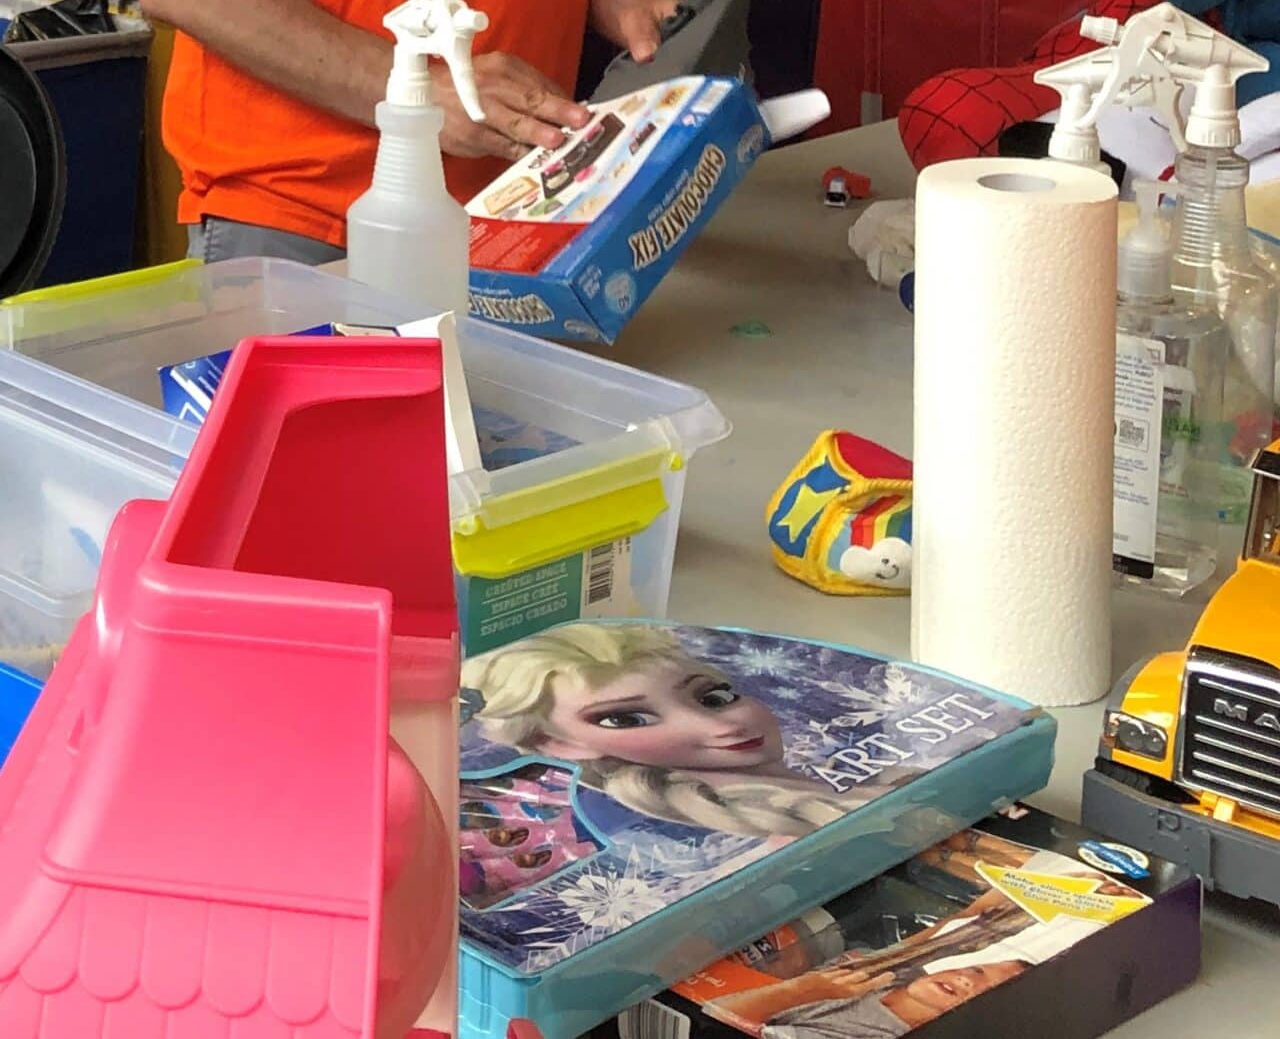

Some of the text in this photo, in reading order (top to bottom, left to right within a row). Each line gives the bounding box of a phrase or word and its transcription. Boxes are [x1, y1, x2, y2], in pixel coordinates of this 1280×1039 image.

[657, 145, 726, 249] CHOCOLATE
[630, 228, 661, 269] FIX
[809, 693, 996, 793] ART SET
[1214, 697, 1280, 732] MA
